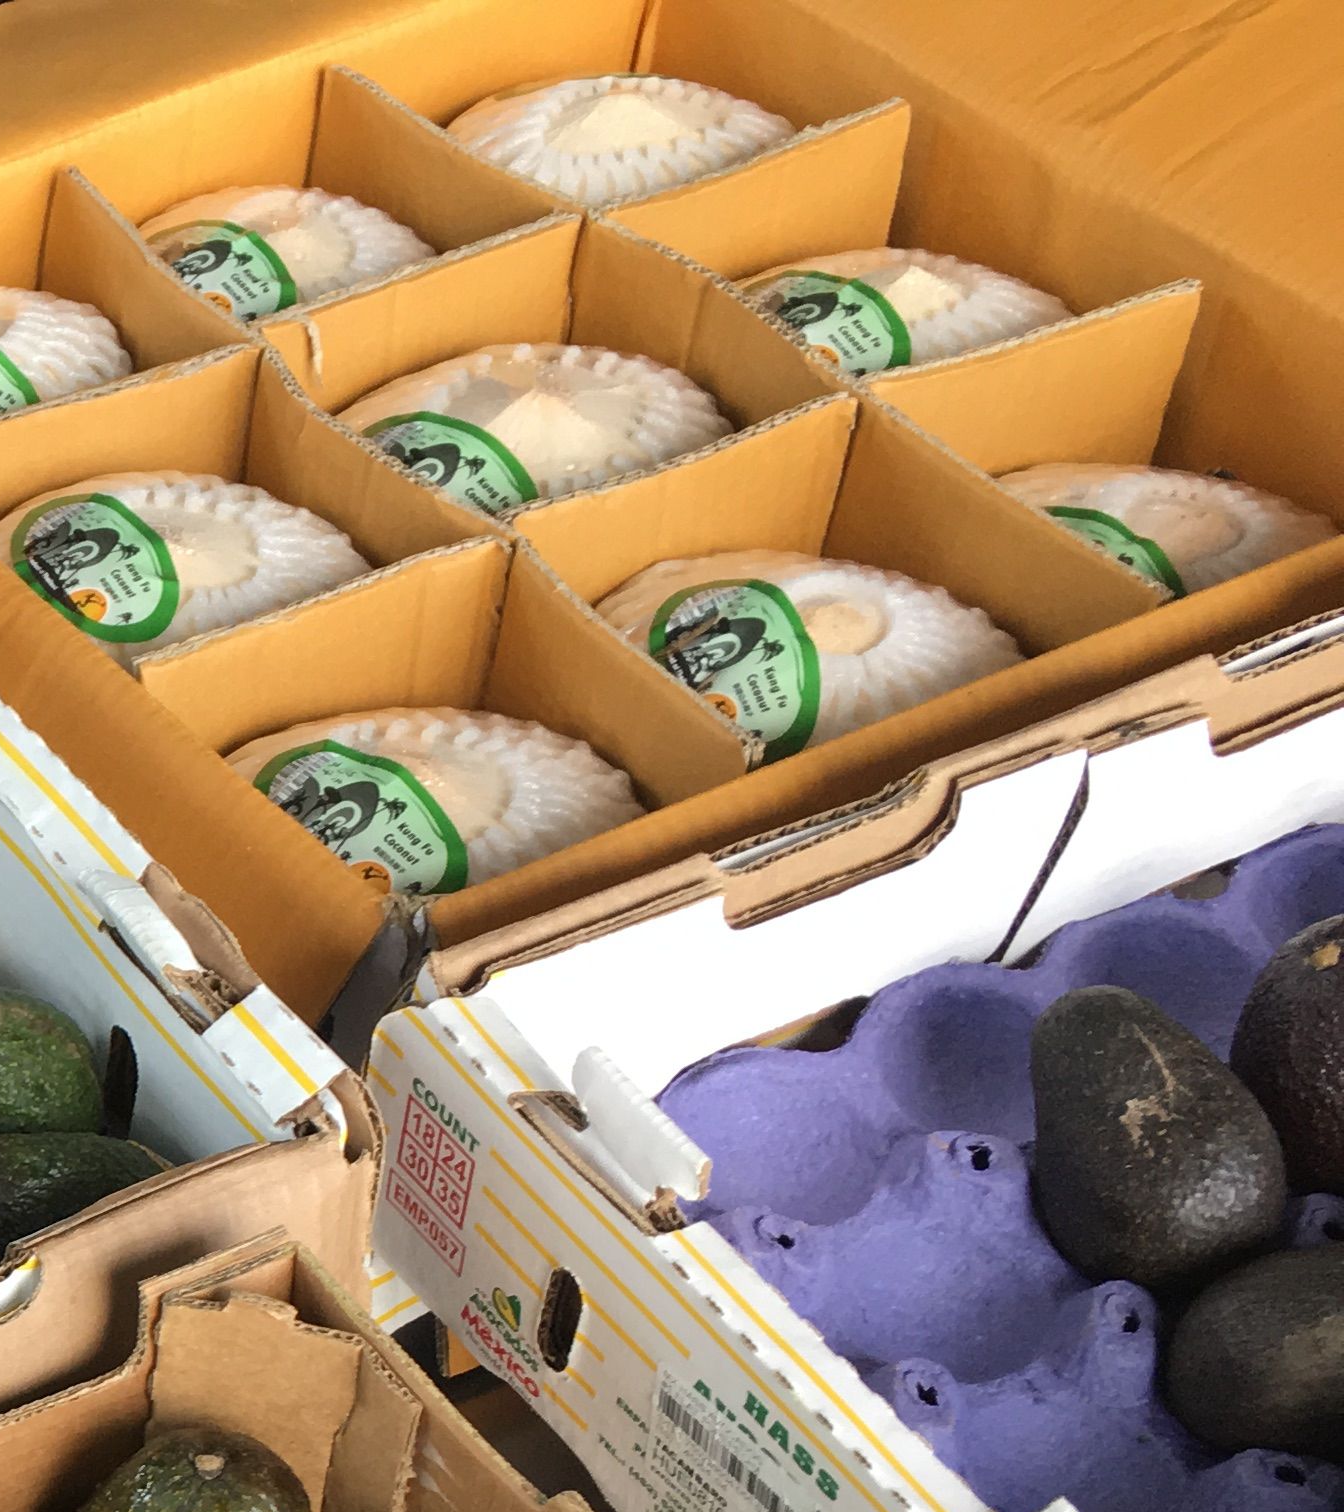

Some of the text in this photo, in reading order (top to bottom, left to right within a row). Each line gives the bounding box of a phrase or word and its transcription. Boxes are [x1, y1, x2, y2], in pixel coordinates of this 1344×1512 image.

[110, 568, 137, 599] Coconut
[125, 561, 143, 584] Kung
[746, 672, 771, 713] Coconut
[763, 666, 781, 696] Kung
[383, 833, 420, 866] Coconut
[397, 821, 423, 848] Kung
[413, 1078, 480, 1152] COUNT
[413, 1114, 466, 1180] 18 24
[405, 1143, 460, 1215] 30 35
[744, 1391, 839, 1500] HASS
